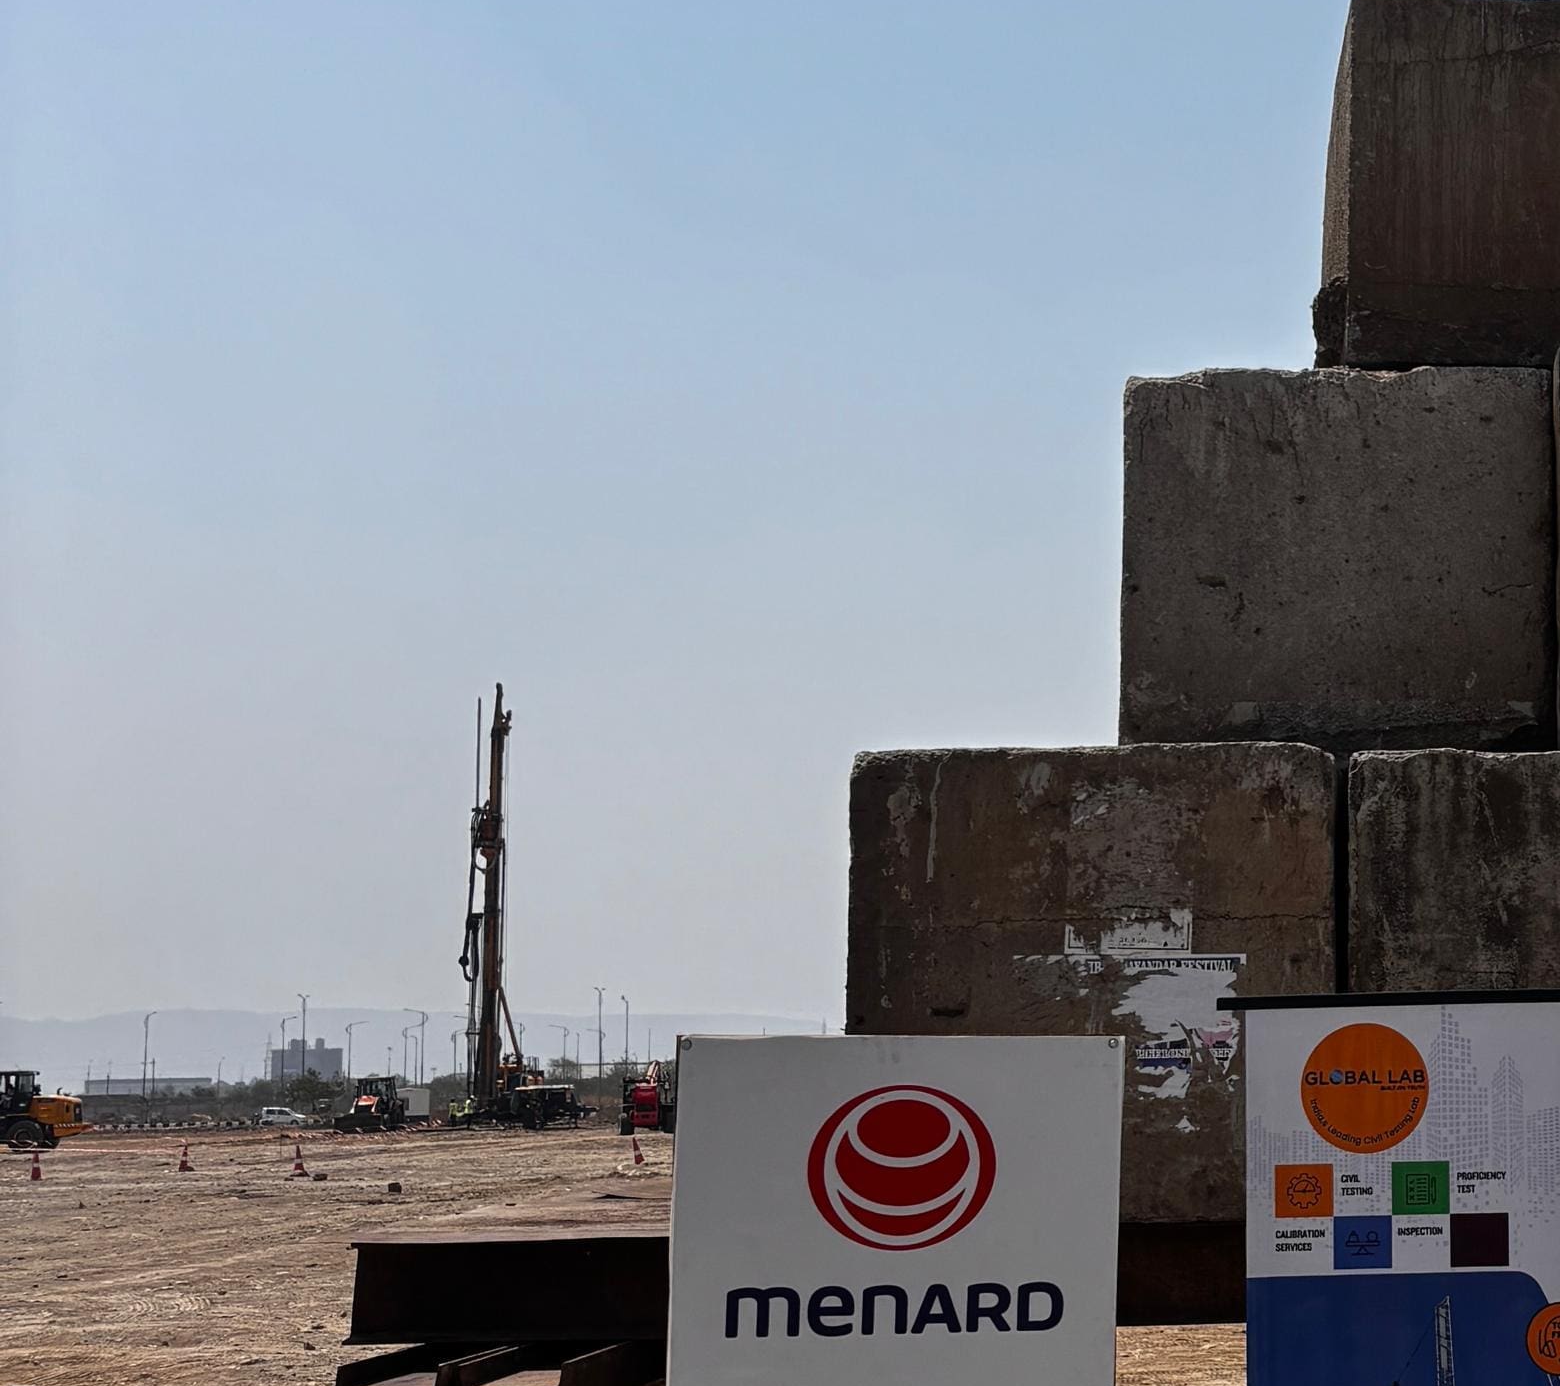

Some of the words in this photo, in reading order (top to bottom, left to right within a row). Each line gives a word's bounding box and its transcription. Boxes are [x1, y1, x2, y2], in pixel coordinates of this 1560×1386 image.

[1305, 1069, 1382, 1085] GLOBAL
[1388, 1069, 1425, 1084] LAB
[1328, 1125, 1362, 1146] Leading
[1364, 1134, 1383, 1145] Civil
[1384, 1114, 1414, 1139] Testing
[1410, 1096, 1420, 1114] Lab
[1341, 1174, 1360, 1184] CIVIL
[1456, 1171, 1506, 1181] PROFICIENCY
[1341, 1187, 1374, 1196] TESTING
[1457, 1184, 1476, 1194] TEST
[1275, 1229, 1326, 1239] CALIBRATION
[1398, 1226, 1443, 1237] INSPECTION
[1275, 1243, 1313, 1252] SERVICES
